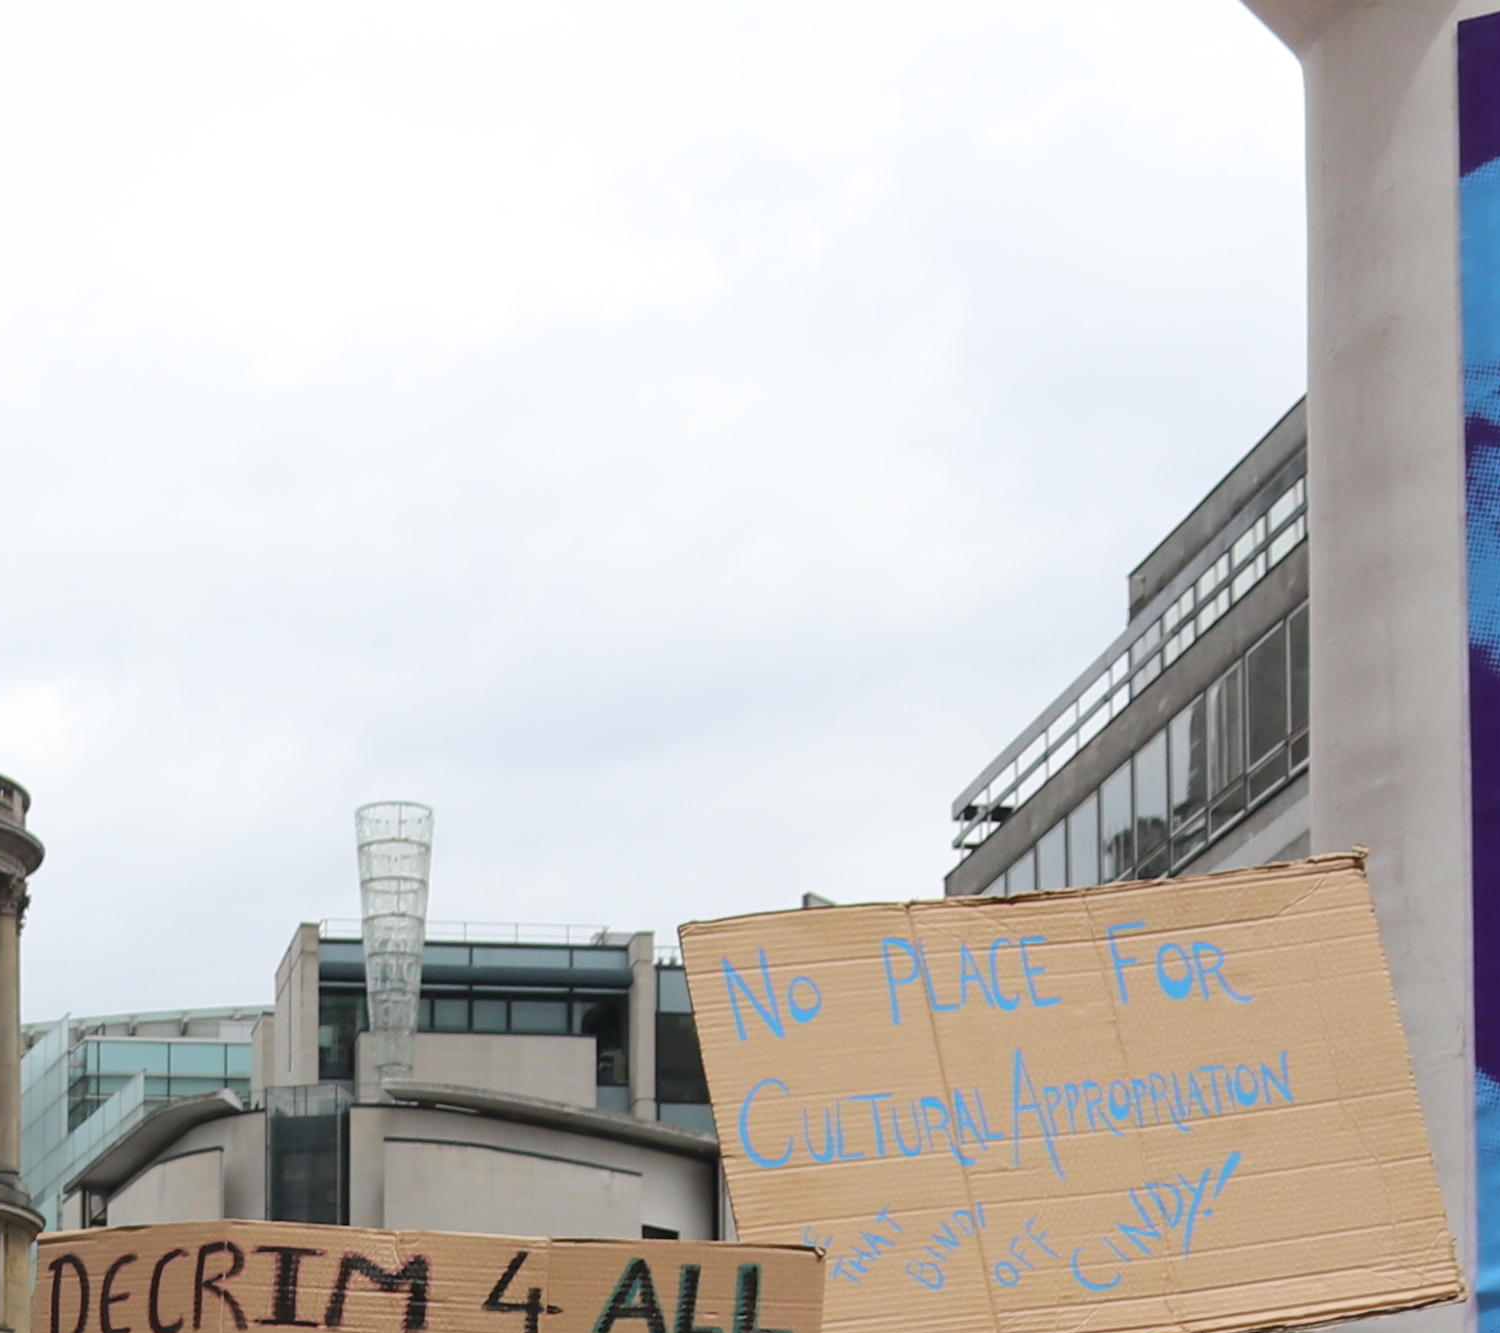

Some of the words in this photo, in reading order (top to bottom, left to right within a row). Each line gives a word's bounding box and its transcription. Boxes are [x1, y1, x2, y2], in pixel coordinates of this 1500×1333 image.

[721, 946, 822, 1041] NO
[881, 936, 1061, 1025] PLACE
[1108, 921, 1254, 1004] FOR
[738, 1077, 1003, 1169] CULTURAL
[1010, 1048, 1294, 1181] APPROPRIATION
[832, 1207, 904, 1283] THAT
[905, 1203, 987, 1290] BINDI
[993, 1217, 1059, 1287] OFF
[1071, 1152, 1242, 1292] CINDY!
